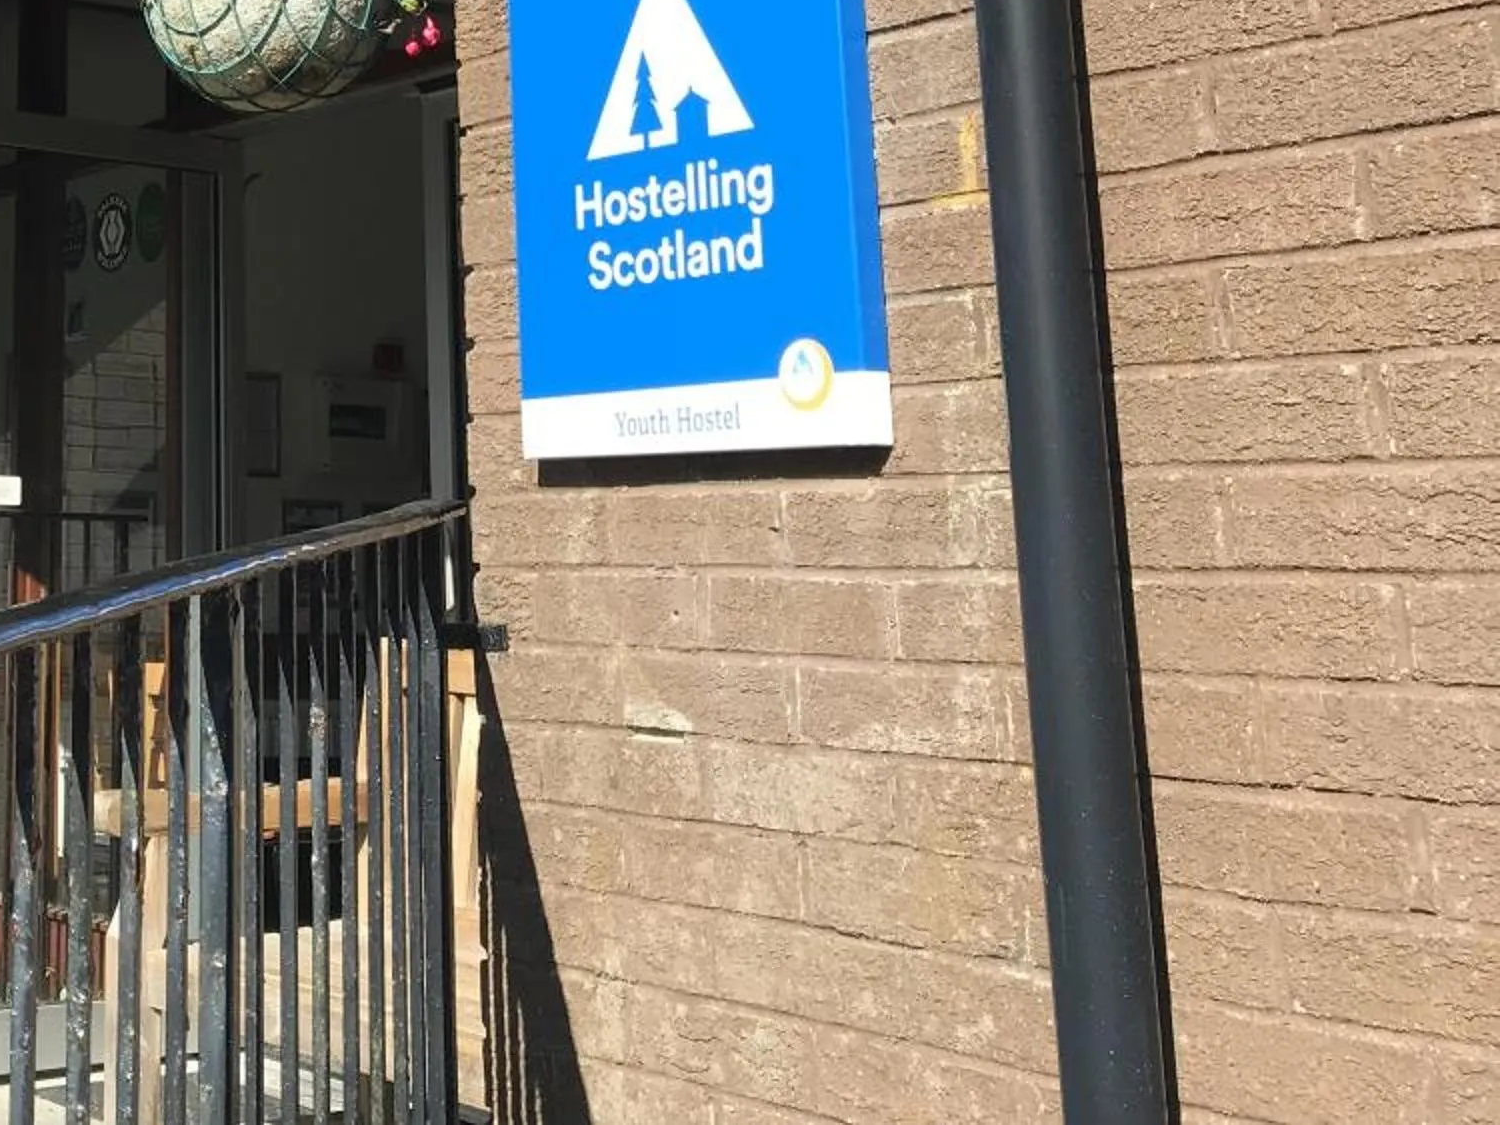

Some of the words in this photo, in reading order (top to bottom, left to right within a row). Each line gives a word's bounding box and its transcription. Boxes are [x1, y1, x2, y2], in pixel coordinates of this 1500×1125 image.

[575, 160, 773, 231] Hostelling
[588, 217, 764, 291] Scotland
[613, 407, 671, 438] Youth
[676, 400, 741, 434] Hostel
